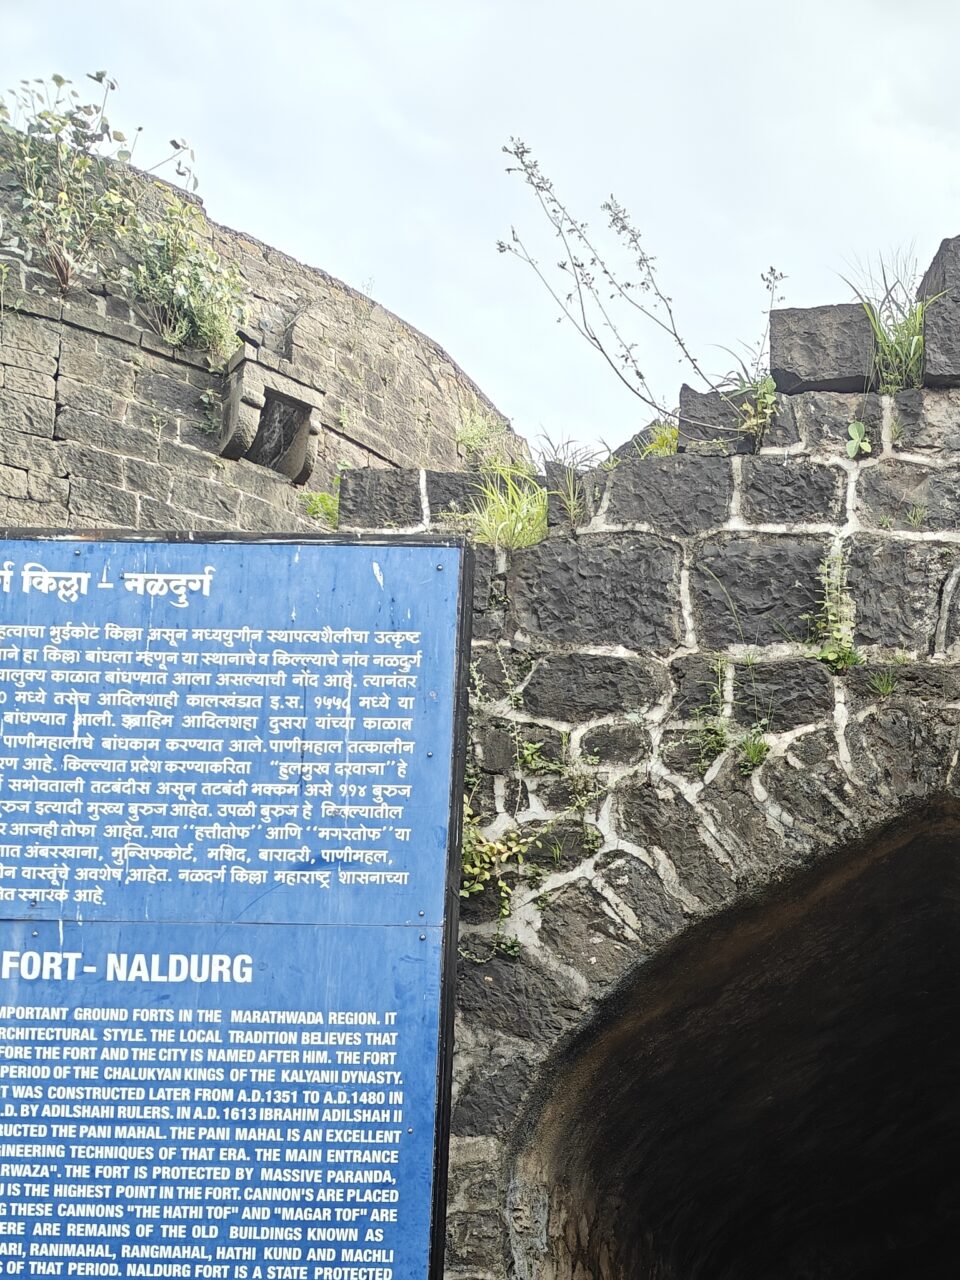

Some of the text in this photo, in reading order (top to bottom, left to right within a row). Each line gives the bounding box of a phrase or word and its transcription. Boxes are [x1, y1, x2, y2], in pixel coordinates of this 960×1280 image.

[124, 565, 217, 608] नळदुर्ग
[84, 647, 134, 663] बांधला
[50, 670, 102, 683] काळात
[171, 673, 213, 685] आला
[215, 670, 288, 686] असल्याची
[14, 687, 48, 705] मध्ये
[96, 689, 180, 709] आदिलशाही
[358, 692, 392, 709] मध्ये
[3, 709, 68, 725] बांधण्यात
[268, 717, 309, 734] दुसरा
[101, 734, 162, 750] बांधकाम
[165, 739, 225, 752] करण्यात
[7, 775, 86, 792] सभोवताली
[90, 778, 152, 794] तटबंदीस
[155, 782, 198, 801] असून
[201, 779, 249, 796] तटबंदी
[34, 798, 84, 815] इत्यादी
[86, 802, 125, 821] मुख्य
[60, 820, 98, 837] तोफा
[265, 823, 304, 839] आणि
[273, 871, 332, 888] महाराष्ट्र
[1, 950, 253, 983] FORT- NALDURG
[73, 1007, 381, 1025] GROUND FORTS THE MARATHWADA REGION.
[102, 1027, 399, 1046] STYLE. THE LOCAL TRADITION BELIEVES THAT
[34, 1046, 397, 1065] THE FORT AND THE CITY NAMED AFTER HIM. THE FORT
[0, 1065, 403, 1085] PERIOD THE CHALUKYAN KINGS THE KALYANII DYNASTY.
[11, 1085, 386, 1105] WAS CONSTRUCTED LATER FROM A.D.1351 A.D.1480
[41, 1104, 391, 1123] ADILSHAHI RULERS. A.D. 1613 IBRAHIM ADILSHAH
[50, 1124, 402, 1143] THE PANI MAHAL. THE PANI MAHAL EXCELLENT
[68, 1145, 399, 1164] TECHNIQUES THAT ERA. THE MAIN ENTRANCE
[64, 1164, 396, 1185] THE FORT PROTECTED MASSIVE PARANDA,
[23, 1183, 50, 1197] THE
[53, 1184, 112, 1198] HIGHEST
[115, 1185, 158, 1199] POINT
[176, 1186, 203, 1200] THE
[204, 1186, 242, 1200] FORT.
[316, 1188, 344, 1202] ARE
[346, 1188, 399, 1203] PLACED
[9, 1202, 53, 1217] THESE
[57, 1203, 124, 1218] CANNONS
[163, 1205, 203, 1219] HATHI
[241, 1206, 271, 1220] AND
[370, 1208, 398, 1222] ARE
[32, 1222, 359, 1242] ARE REMAINS THE OLD BUILDINGS KNOWN
[28, 1243, 394, 1263] RANIMAHAL, RANGMAHAL, HATHI KUND AND MACHLI
[28, 1261, 393, 1280] THAT PERIOD. NALDURG FORT STATE PROTECTED
